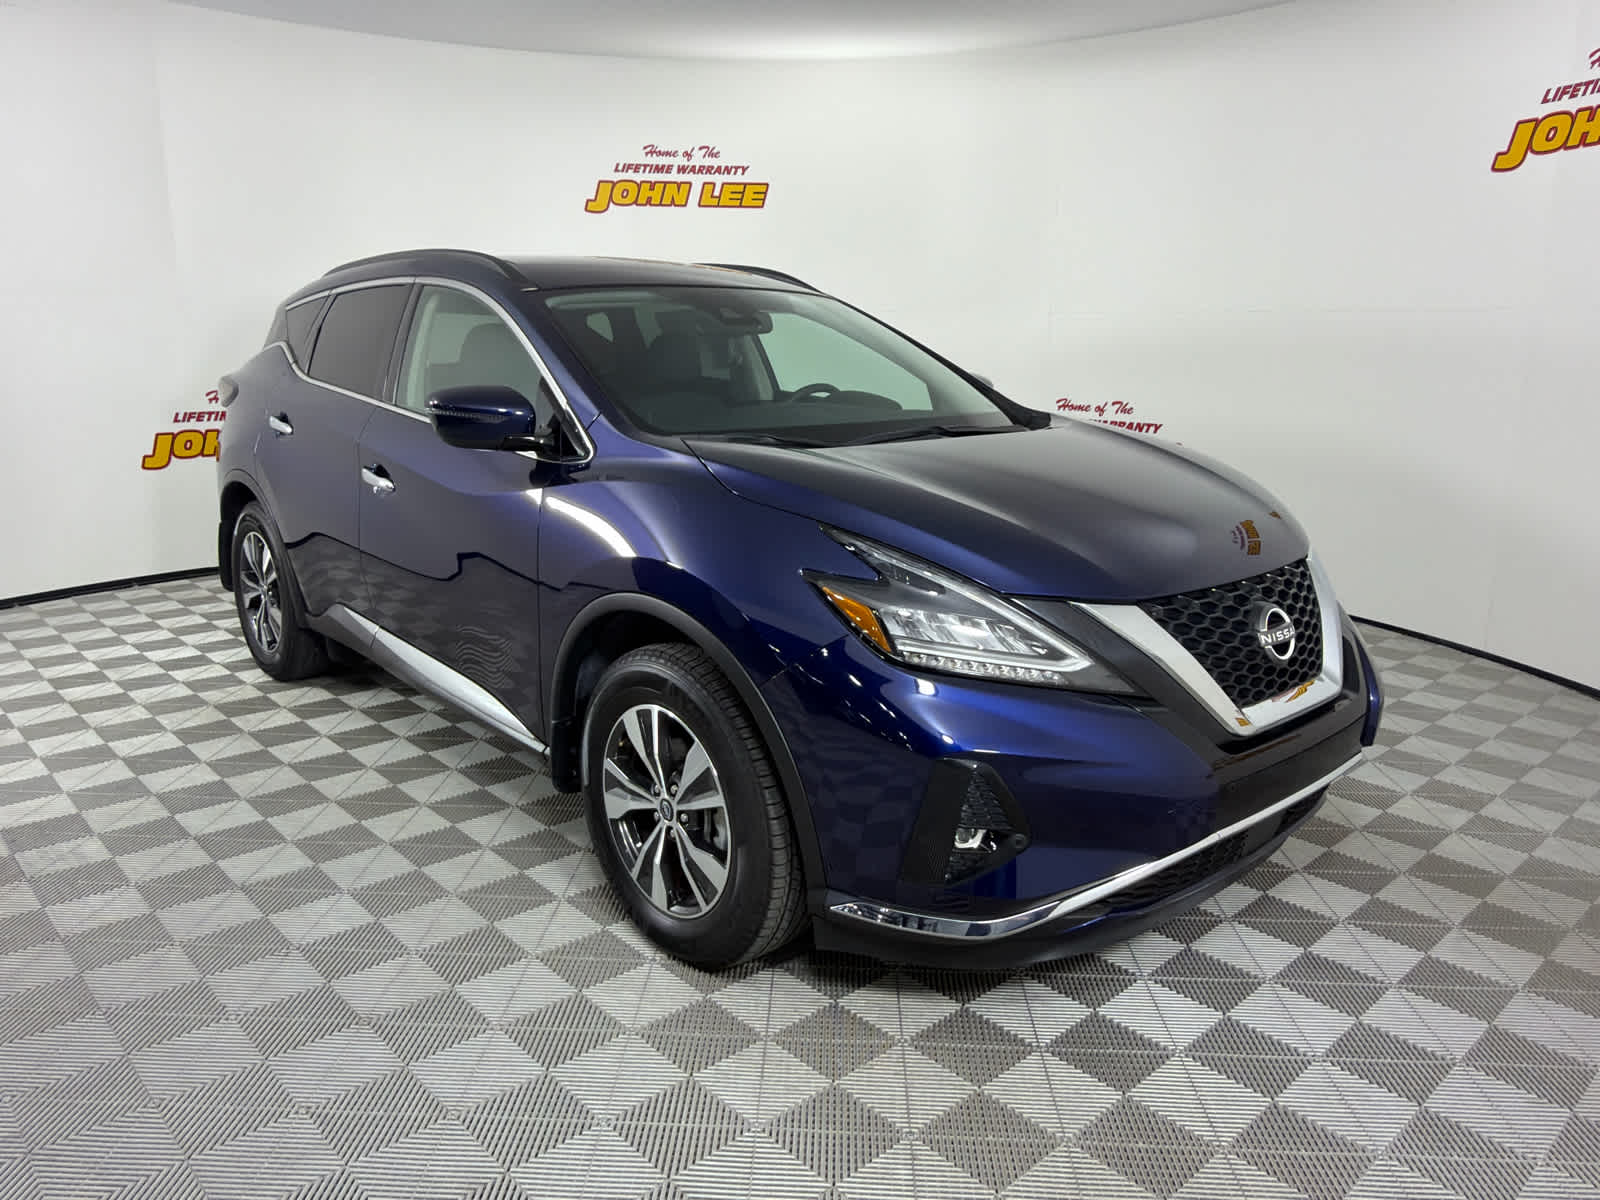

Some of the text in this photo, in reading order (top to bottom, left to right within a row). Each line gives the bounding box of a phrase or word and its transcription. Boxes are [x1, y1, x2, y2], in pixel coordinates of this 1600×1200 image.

[1541, 78, 1600, 104] LIFETI
[1491, 104, 1600, 172] JOH
[643, 144, 721, 162] Home of The
[613, 163, 750, 176] LIFETIME WARRANTY
[584, 179, 769, 214] JOHN LEE
[173, 410, 227, 423] LIFETI
[1056, 398, 1134, 417] Home of The
[141, 428, 221, 470] JOH
[1260, 625, 1295, 644] NISSA
